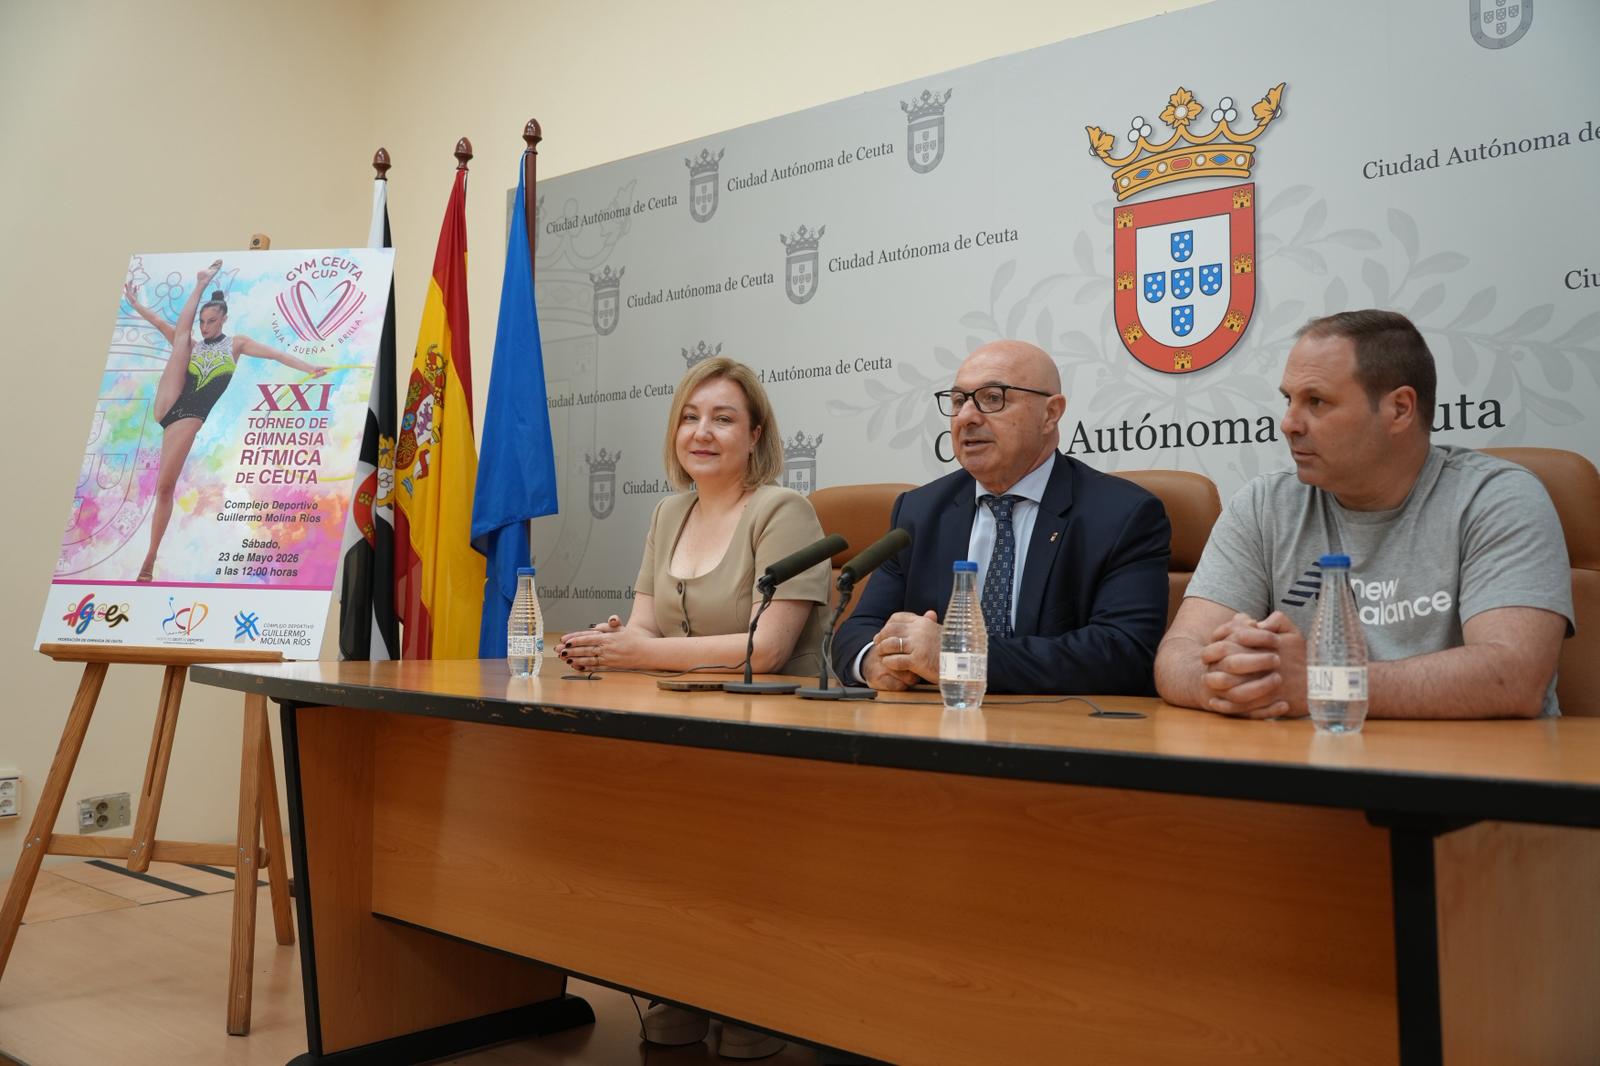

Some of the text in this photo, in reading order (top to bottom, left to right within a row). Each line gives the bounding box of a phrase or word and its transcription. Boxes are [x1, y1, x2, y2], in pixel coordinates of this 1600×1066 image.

[1362, 149, 1440, 180] Ciudad
[1445, 131, 1571, 166] Autónoma
[727, 143, 894, 192] Ciudad Autónoma de Ceuta
[546, 195, 678, 234] Ciudad Autónoma de Ceuta
[828, 228, 1019, 273] Ciudad Autónoma de Ceuta
[286, 256, 363, 281] GYM CEUTA
[311, 269, 338, 280] CUP
[626, 272, 774, 308] Ciudad Autónoma de Ceuta
[272, 319, 285, 343] VIAJA
[338, 319, 362, 344] BRILLA
[293, 344, 326, 355] SUEÑA
[768, 364, 832, 383] Autónoma
[835, 359, 851, 375] de
[854, 356, 893, 373] Ceuta
[251, 383, 335, 411] XXI
[547, 383, 674, 408] iudad Autónoma de Ceuta
[248, 417, 329, 429] TORNEO DE
[1065, 394, 1506, 455] Autónoma uta
[244, 432, 324, 446] GIMNASIA
[240, 447, 321, 466] RÍTMICA
[235, 469, 318, 485] DE CEUTA
[623, 479, 659, 495] Ciudad
[224, 500, 319, 511] Complejo Deportivo
[216, 512, 262, 522] Guillermo
[265, 513, 297, 523] Molina
[241, 538, 281, 550] Sábado,
[218, 552, 299, 564] 23 de Mayo 2026
[215, 566, 298, 577] a las 12:00 horas
[537, 584, 569, 599] Ciudad
[572, 586, 622, 599] Autónoma
[1350, 577, 1400, 601] new
[1359, 590, 1452, 625] alance
[260, 637, 291, 645] MOLINA
[262, 629, 306, 637] GUILLERMO
